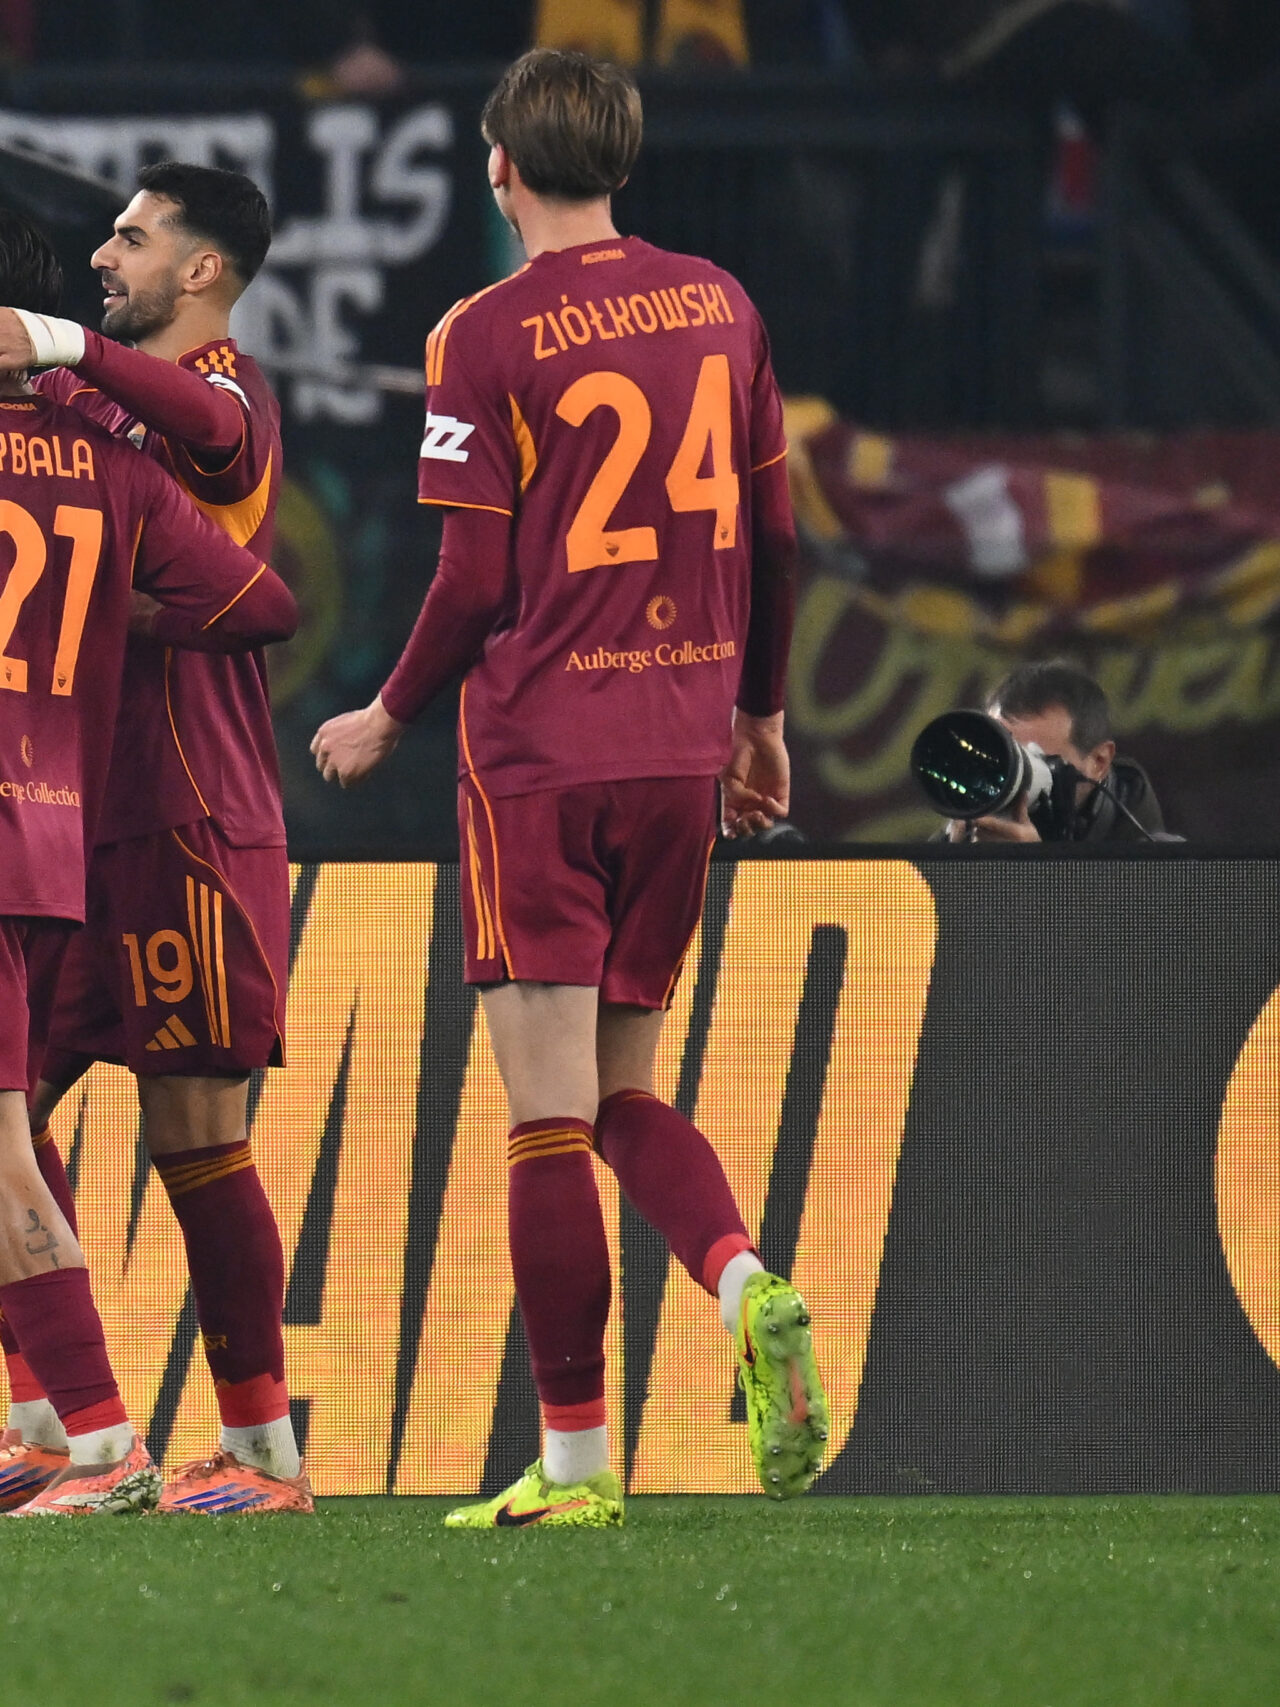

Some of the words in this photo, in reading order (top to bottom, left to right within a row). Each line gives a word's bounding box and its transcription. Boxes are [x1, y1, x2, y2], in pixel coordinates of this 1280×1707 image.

[521, 282, 735, 361] ZIÓŁKOWSKI
[555, 353, 740, 574] 24
[564, 646, 652, 674] Auberge
[655, 640, 736, 666] Collecton
[26, 781, 81, 808] Collectio
[122, 929, 192, 1008] 19
